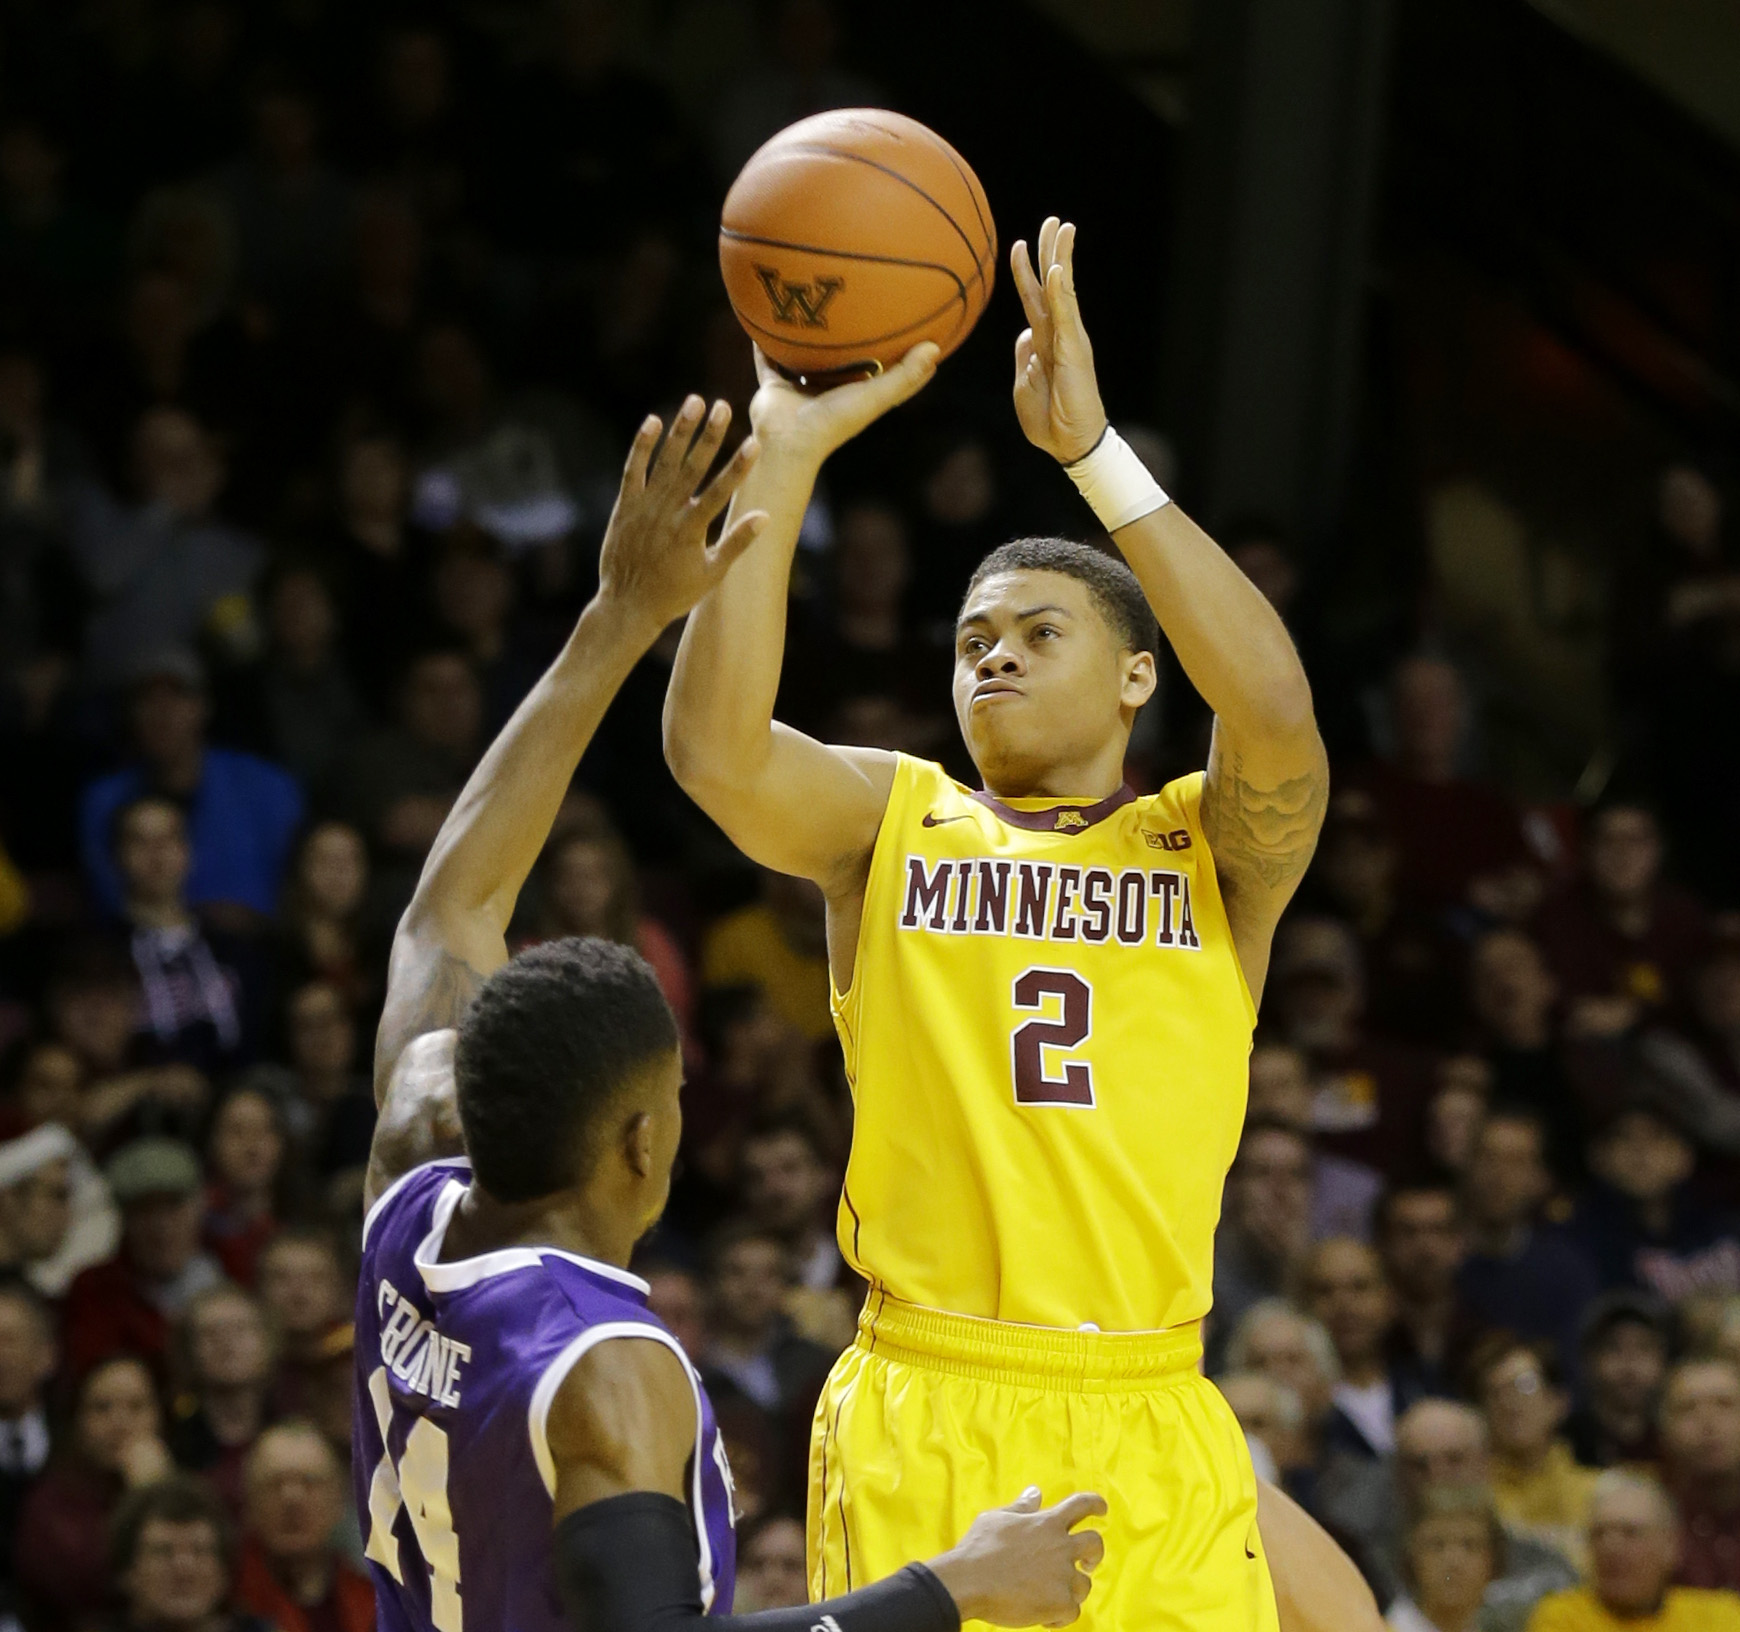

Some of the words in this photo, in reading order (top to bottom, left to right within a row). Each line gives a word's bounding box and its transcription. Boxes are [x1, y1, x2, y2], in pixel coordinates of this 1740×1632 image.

[754, 264, 844, 330] W
[899, 854, 1202, 951] MINNESOTA
[1010, 964, 1096, 1109] 2
